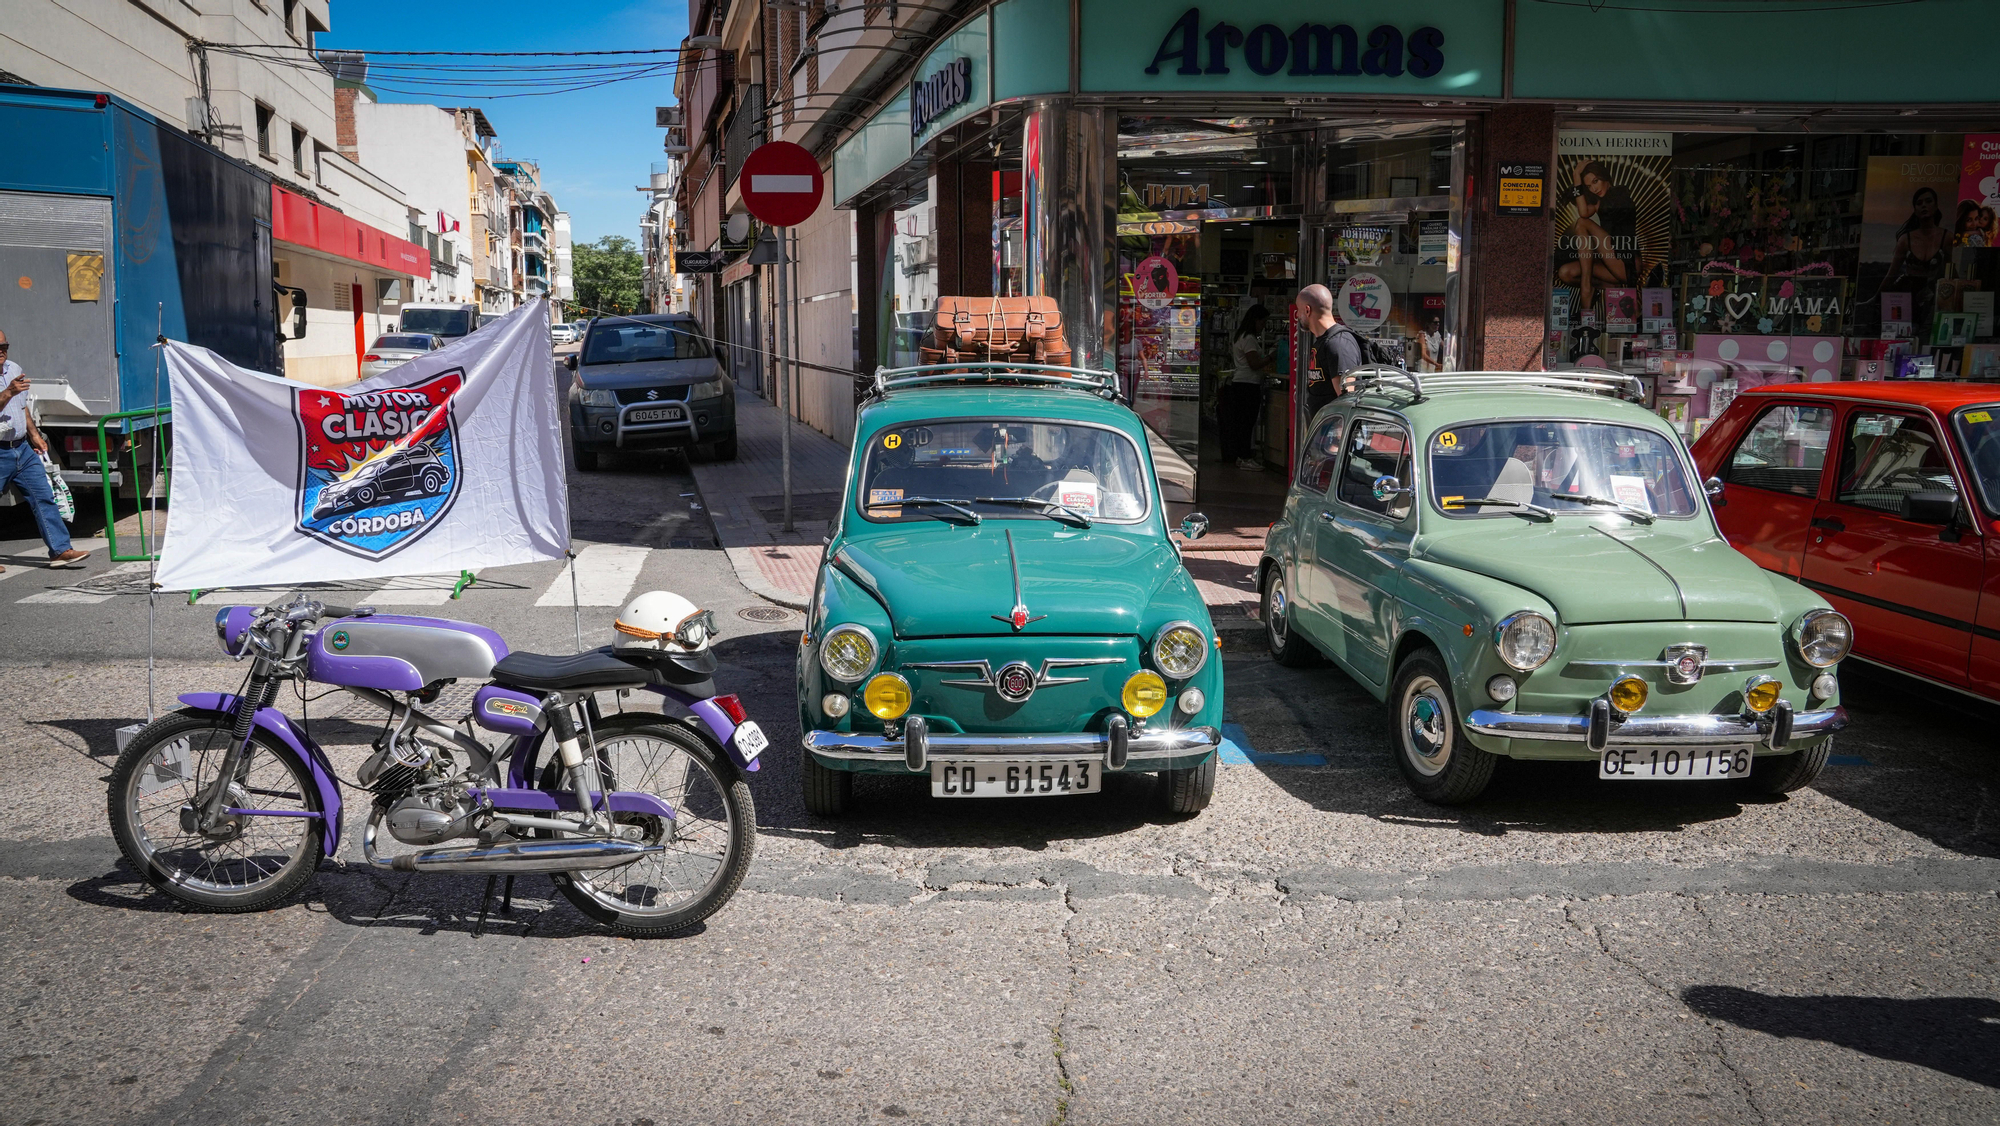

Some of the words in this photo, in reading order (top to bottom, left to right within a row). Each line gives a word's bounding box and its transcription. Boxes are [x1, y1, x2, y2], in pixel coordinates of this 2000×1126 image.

[1144, 7, 1445, 78] Aromas
[1606, 137, 1669, 148] HERRERA
[1558, 235, 1600, 250] GOOD
[1603, 235, 1645, 250] GIRL
[1349, 277, 1376, 287] Regala
[1703, 295, 1714, 313] I
[1767, 296, 1841, 315] MAMA
[341, 391, 430, 411] MOTOR
[635, 411, 659, 420] 6045
[661, 408, 680, 419] FYK
[888, 435, 898, 447] H
[1443, 434, 1454, 445] H
[328, 507, 427, 535] CÓRDOBA
[944, 766, 976, 795] CO
[1006, 763, 1090, 794] 61543
